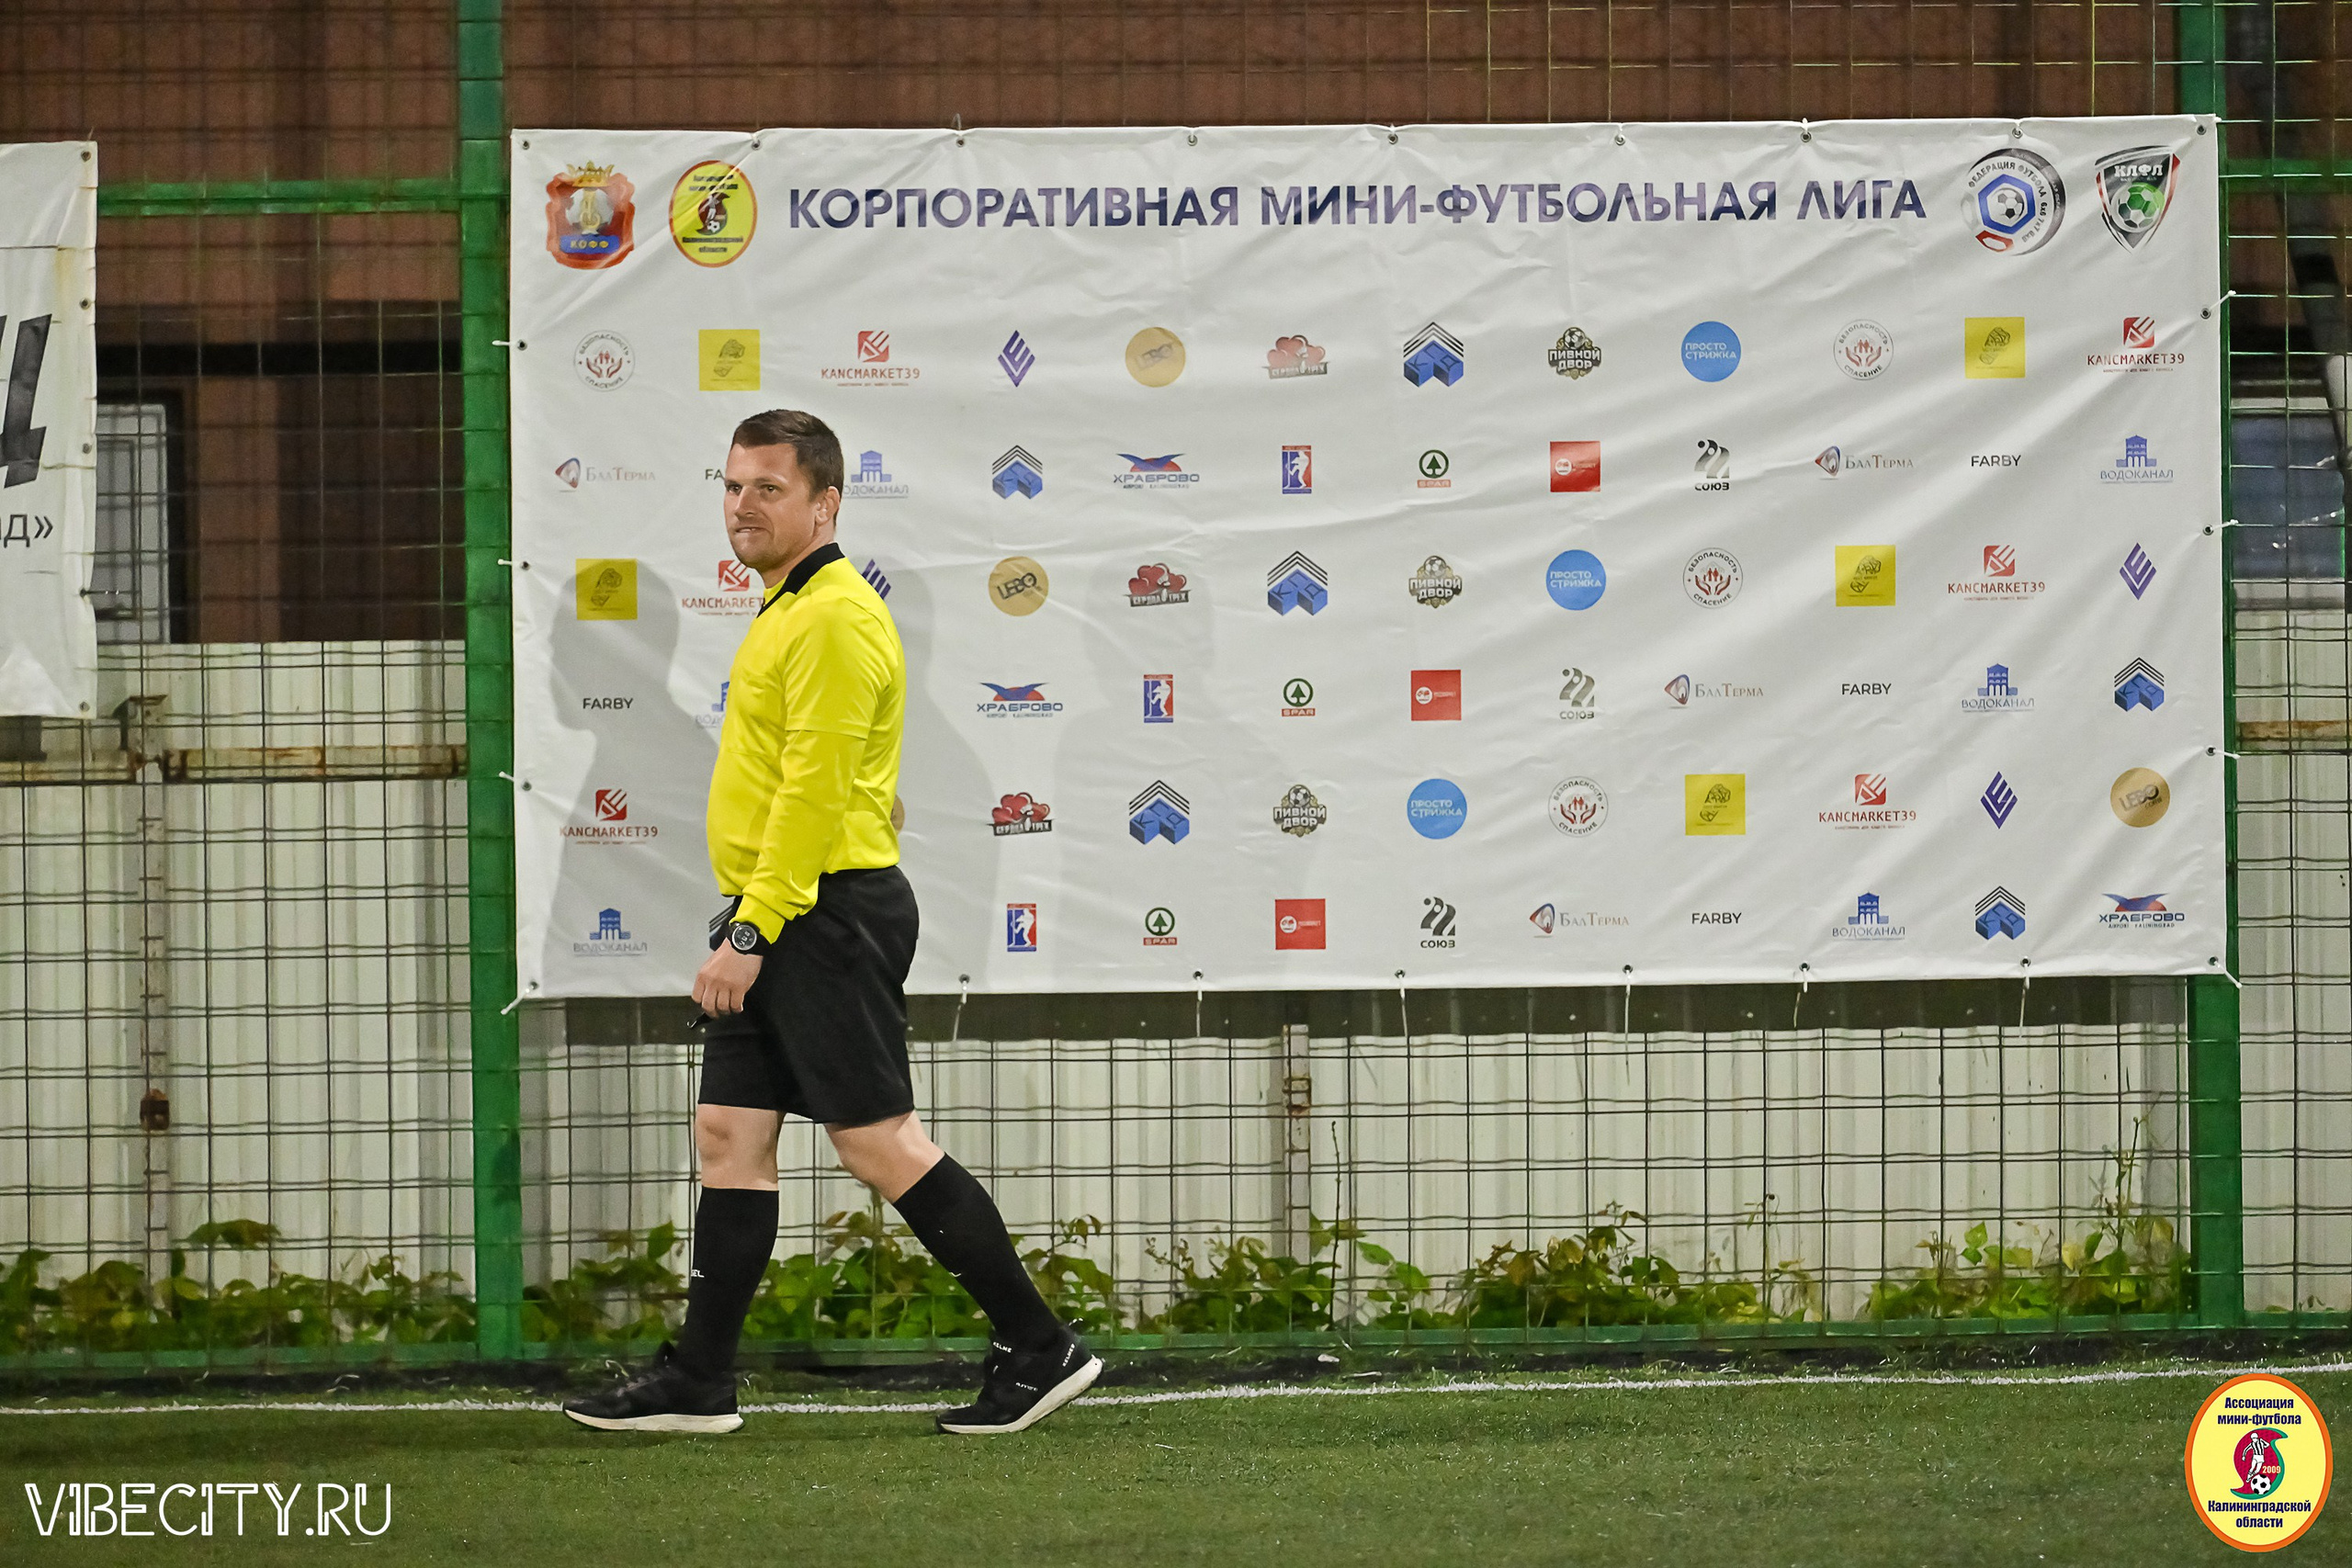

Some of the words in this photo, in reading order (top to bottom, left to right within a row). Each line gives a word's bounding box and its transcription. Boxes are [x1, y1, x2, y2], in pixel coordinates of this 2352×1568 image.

[2113, 164, 2164, 177] КЛФЛ
[1968, 161, 2017, 188] ФЕДЕРАЦИЯ
[2018, 164, 2048, 197] ФУТБОЛА
[789, 186, 1239, 230] КОРПОРАТИВНАЯ
[1260, 181, 1777, 226] МИНИ-ФУТБОЛЬНАЯ
[1796, 179, 1928, 220] ЛИГА
[1684, 342, 1727, 351] ПРОСТО
[1548, 347, 1601, 361] ПИВНОЙ
[1684, 350, 1737, 361] СТРИЖКА
[2086, 352, 2186, 367] KANCMARKET39
[1556, 360, 1593, 371] ДВОР
[1843, 363, 1883, 378] СПАСЕНИЕ
[820, 367, 921, 380] KANCMARKET39
[1970, 455, 2021, 468] FARBY
[1113, 473, 1200, 483] ХРАБРОВО
[2099, 469, 2175, 481] ВОДОКАНАЛ
[843, 484, 910, 496] ОДОКАНАЛ
[1694, 481, 1730, 491] СОЮЗ
[1687, 550, 1738, 574] БЕЗОПАСНОСТЬ
[1549, 570, 1592, 580] ПРОСТО
[1408, 577, 1463, 590] ПИВНОЙ
[1549, 579, 1602, 589] СТРИЖКА
[1947, 581, 2046, 594] KANCMARKET39
[1418, 589, 1453, 600] ДВОР
[1692, 592, 1733, 606] СПАСЕНИЕ
[681, 597, 765, 609] KANCMARKET
[1841, 682, 1893, 695] FARBY
[582, 697, 634, 710] FARBY
[976, 703, 1064, 713] ХРАБРОВО
[1961, 698, 2035, 710] ВОДОКАНАЛ
[1559, 710, 1595, 720] СОЮЗ
[1410, 799, 1453, 808] ПРОСТО
[1273, 806, 1327, 818] ПИВНОЙ
[1410, 807, 1464, 818] СТРИЖКА
[1818, 810, 1917, 823] KANCMARKET39
[1282, 818, 1318, 829] ДВОР
[1557, 820, 1599, 836] СПАСЕНИЕ
[559, 826, 659, 838] KANCMARKET39
[1690, 912, 1742, 925] FARBY
[2098, 912, 2185, 923] ХРАБРОВО
[1832, 926, 1906, 938] ВОДОКАНАЛ
[573, 942, 648, 953] ВОДОКАНАЛ
[1419, 939, 1456, 949] СОЮЗ
